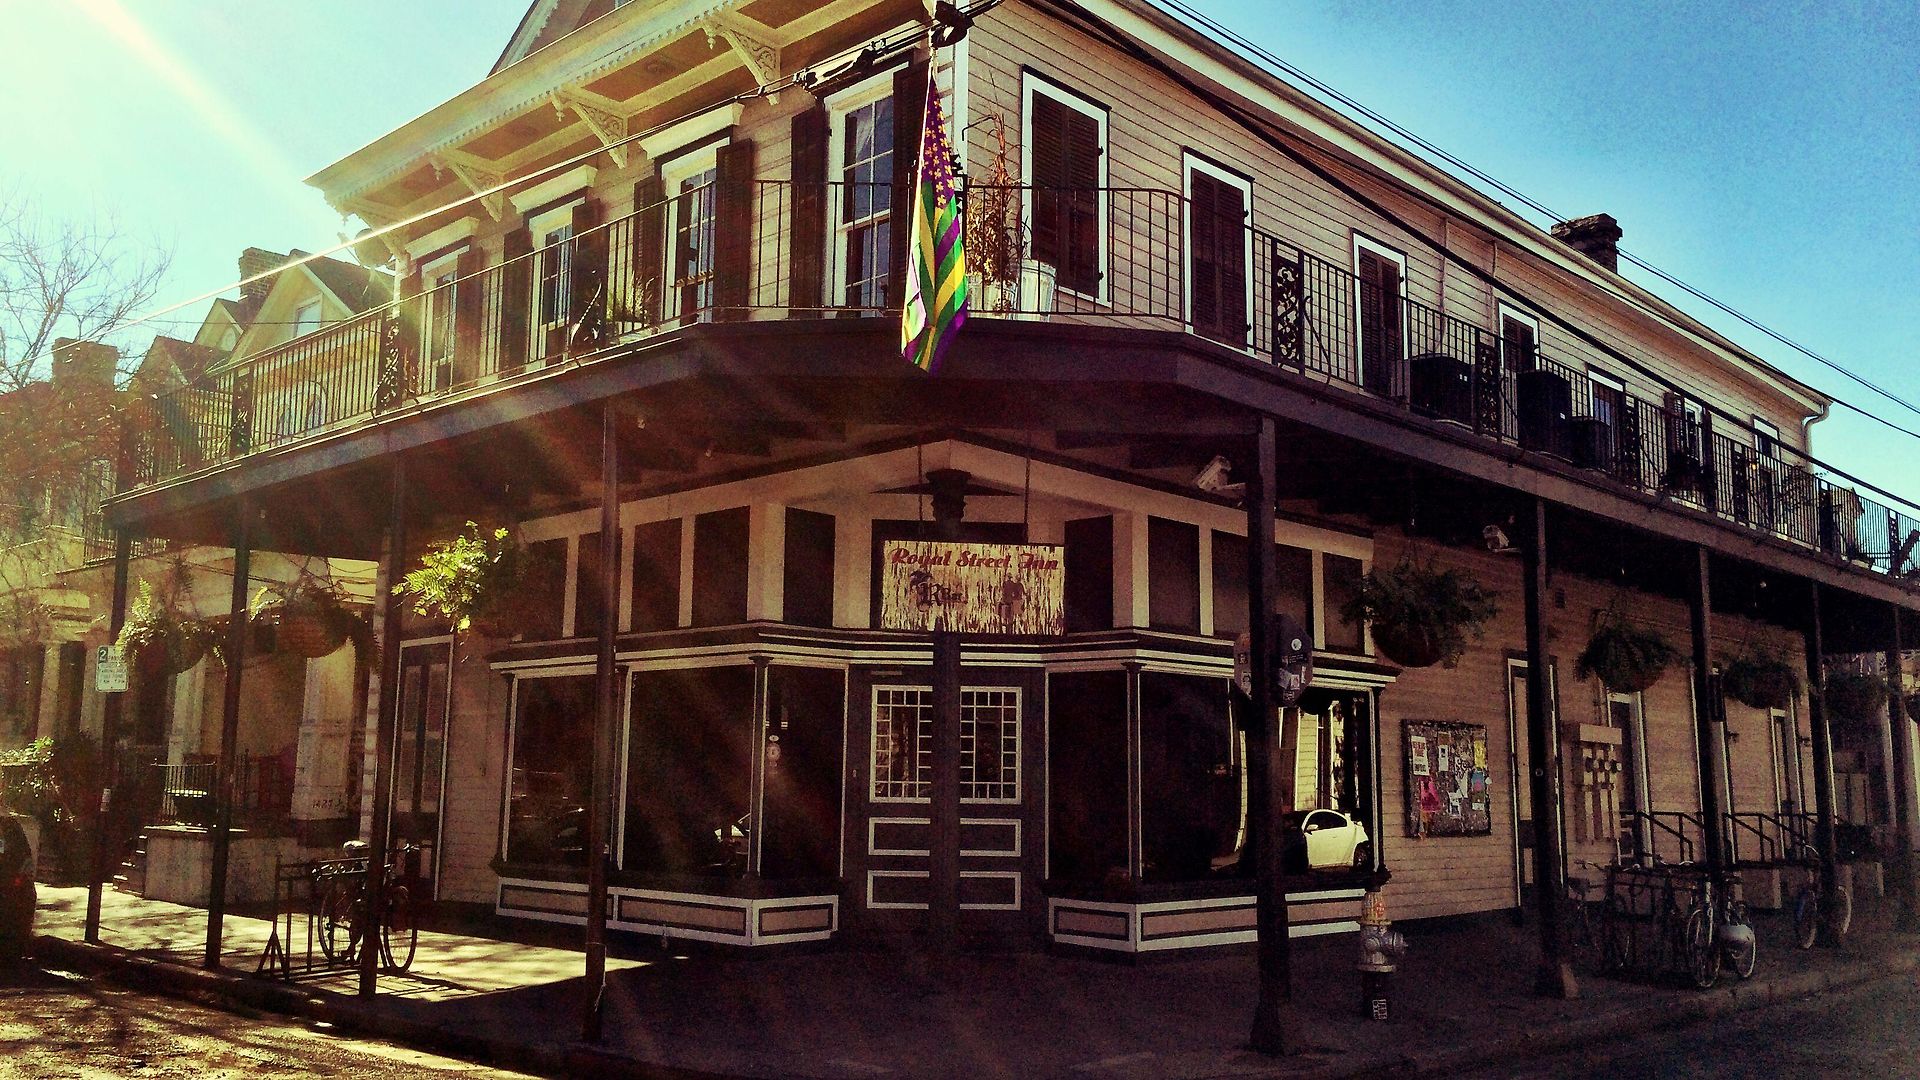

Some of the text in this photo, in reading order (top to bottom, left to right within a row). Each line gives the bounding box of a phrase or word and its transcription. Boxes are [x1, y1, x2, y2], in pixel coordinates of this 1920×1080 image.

[890, 547, 1059, 570] Royal Street Inn
[99, 649, 107, 661] 2
